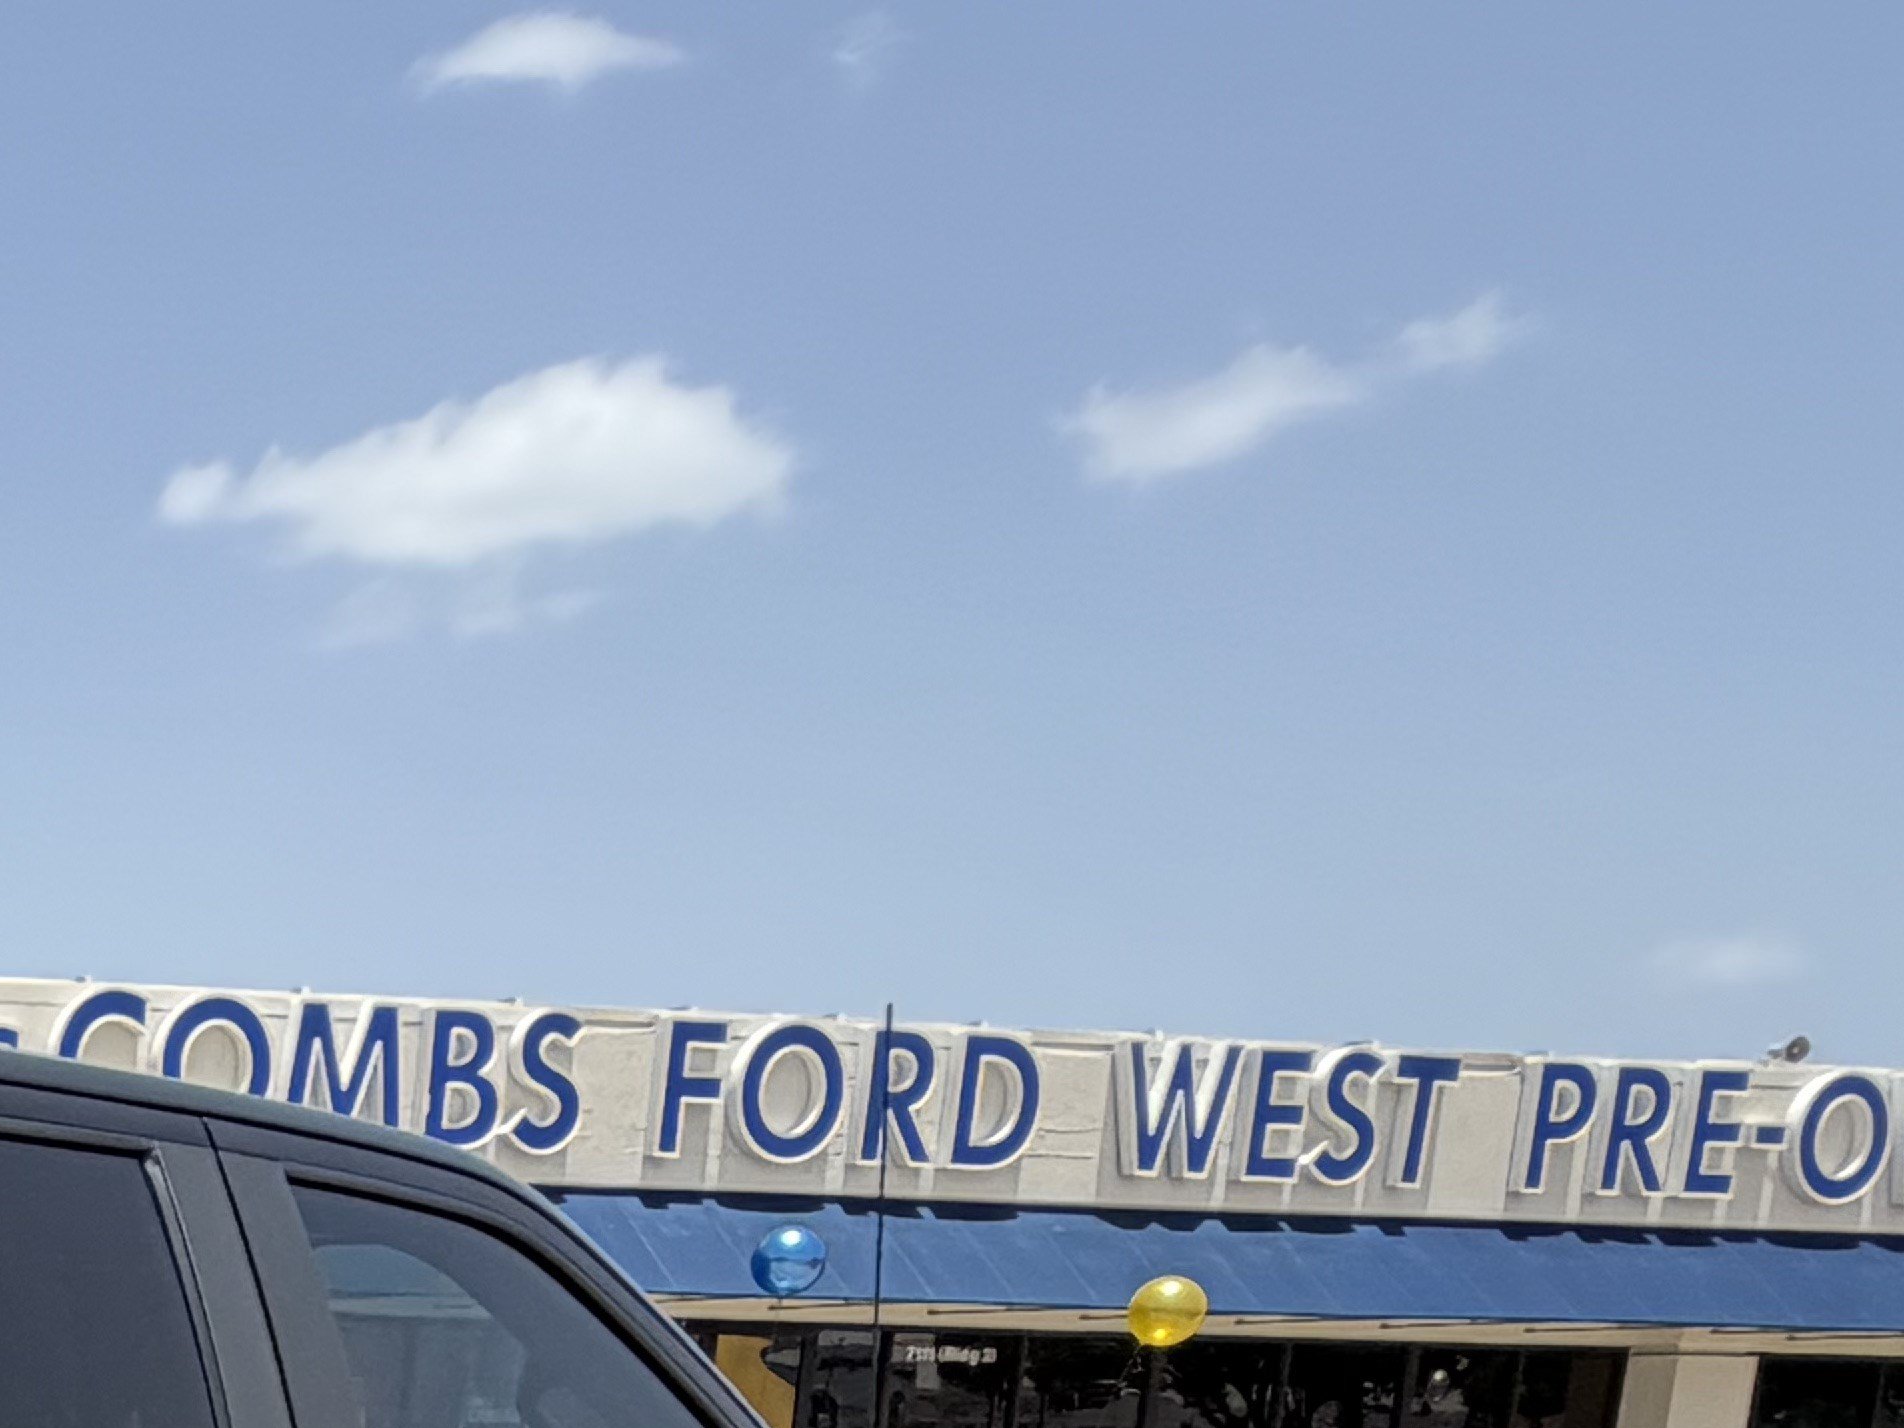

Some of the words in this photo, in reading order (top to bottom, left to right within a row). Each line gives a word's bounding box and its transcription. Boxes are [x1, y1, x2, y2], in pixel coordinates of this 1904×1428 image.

[658, 1021, 1040, 1166] FORD
[1131, 1042, 1461, 1184] WEST
[1523, 1062, 1888, 1200] PRE-O
